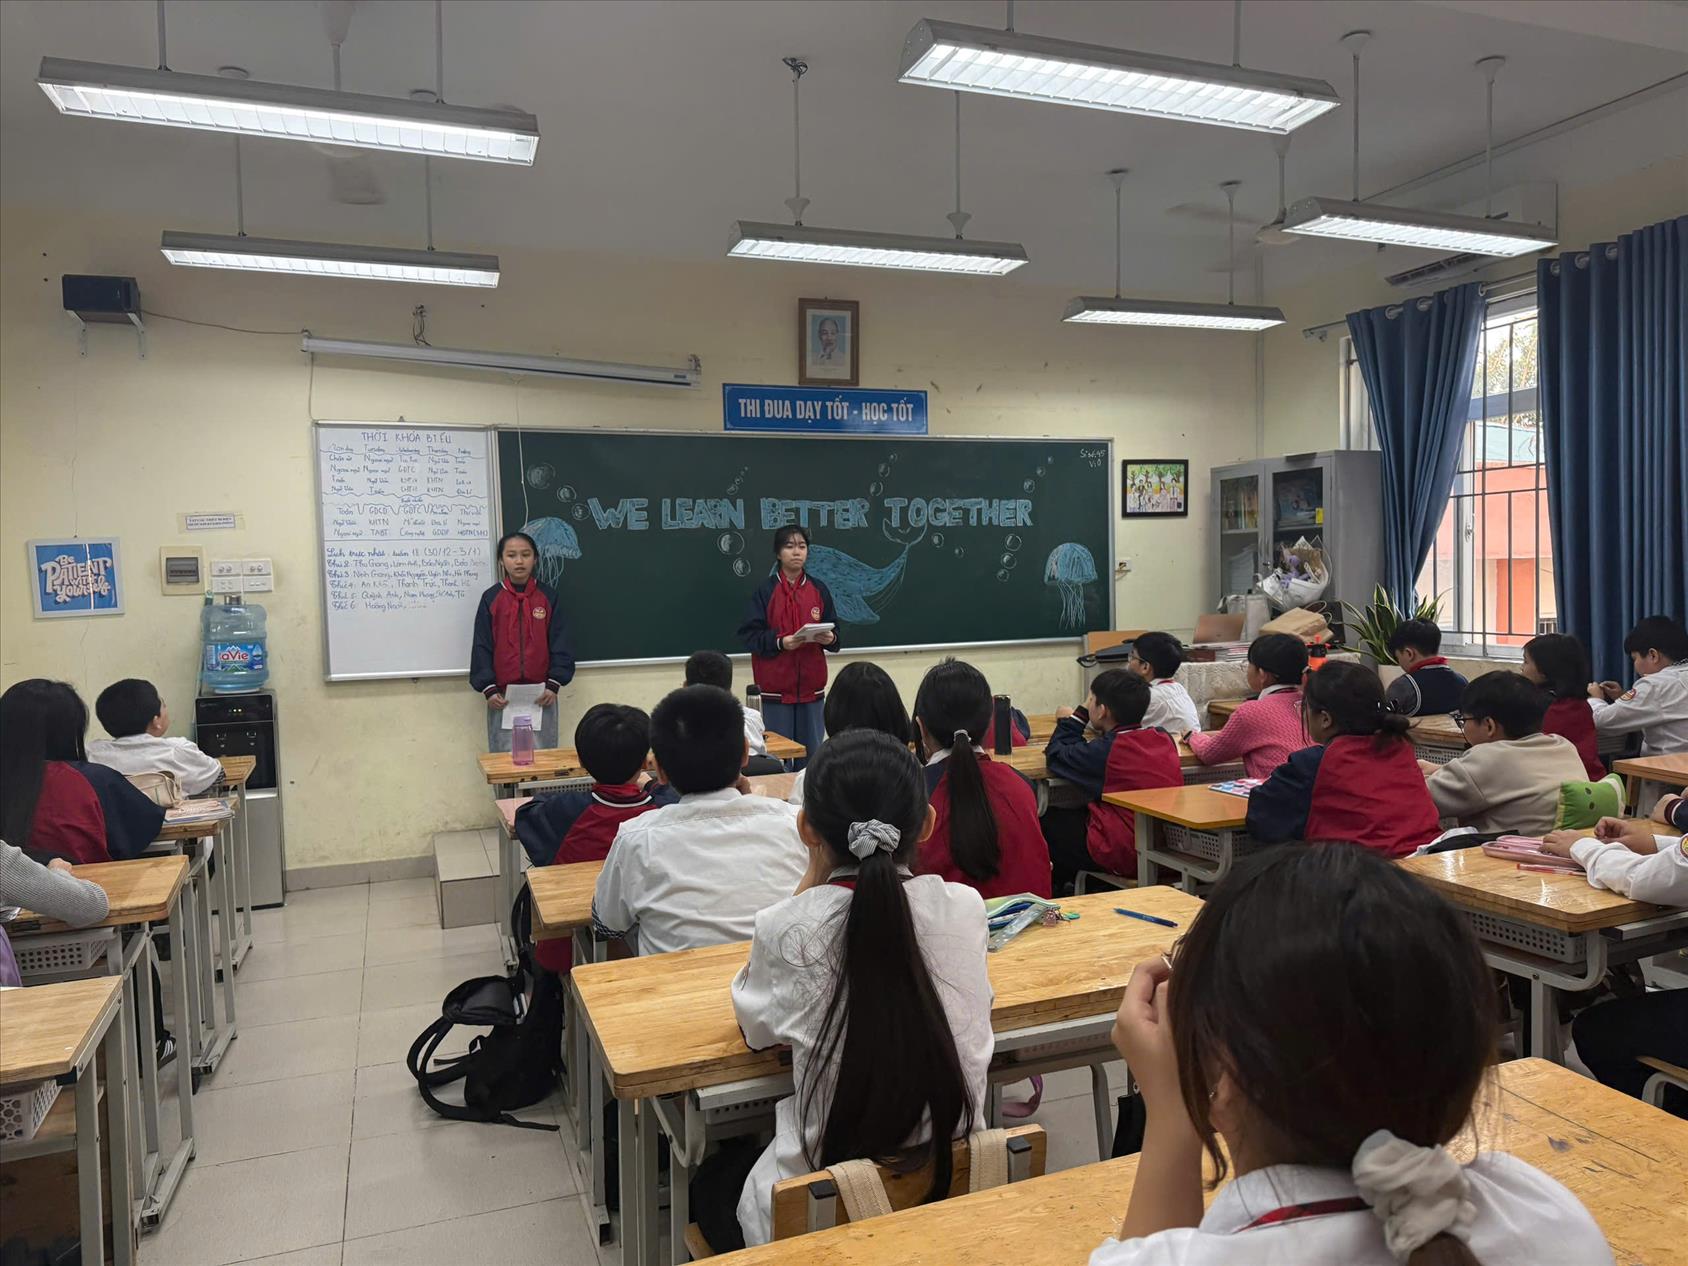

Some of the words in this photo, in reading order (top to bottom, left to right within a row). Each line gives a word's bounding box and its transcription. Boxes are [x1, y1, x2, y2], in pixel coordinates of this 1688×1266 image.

[739, 399, 760, 417] THI
[764, 400, 792, 419] ĐUA
[796, 401, 822, 423] DẠY
[826, 395, 849, 420] TỐT
[862, 402, 888, 425] HỌC
[891, 397, 914, 421] TỐT
[395, 431, 421, 442] KHÓA
[587, 497, 649, 530] WE
[661, 497, 745, 530] LEARN
[759, 497, 871, 530] BETTER
[884, 497, 1033, 528] TOGETHER
[40, 557, 113, 593] PATIENT
